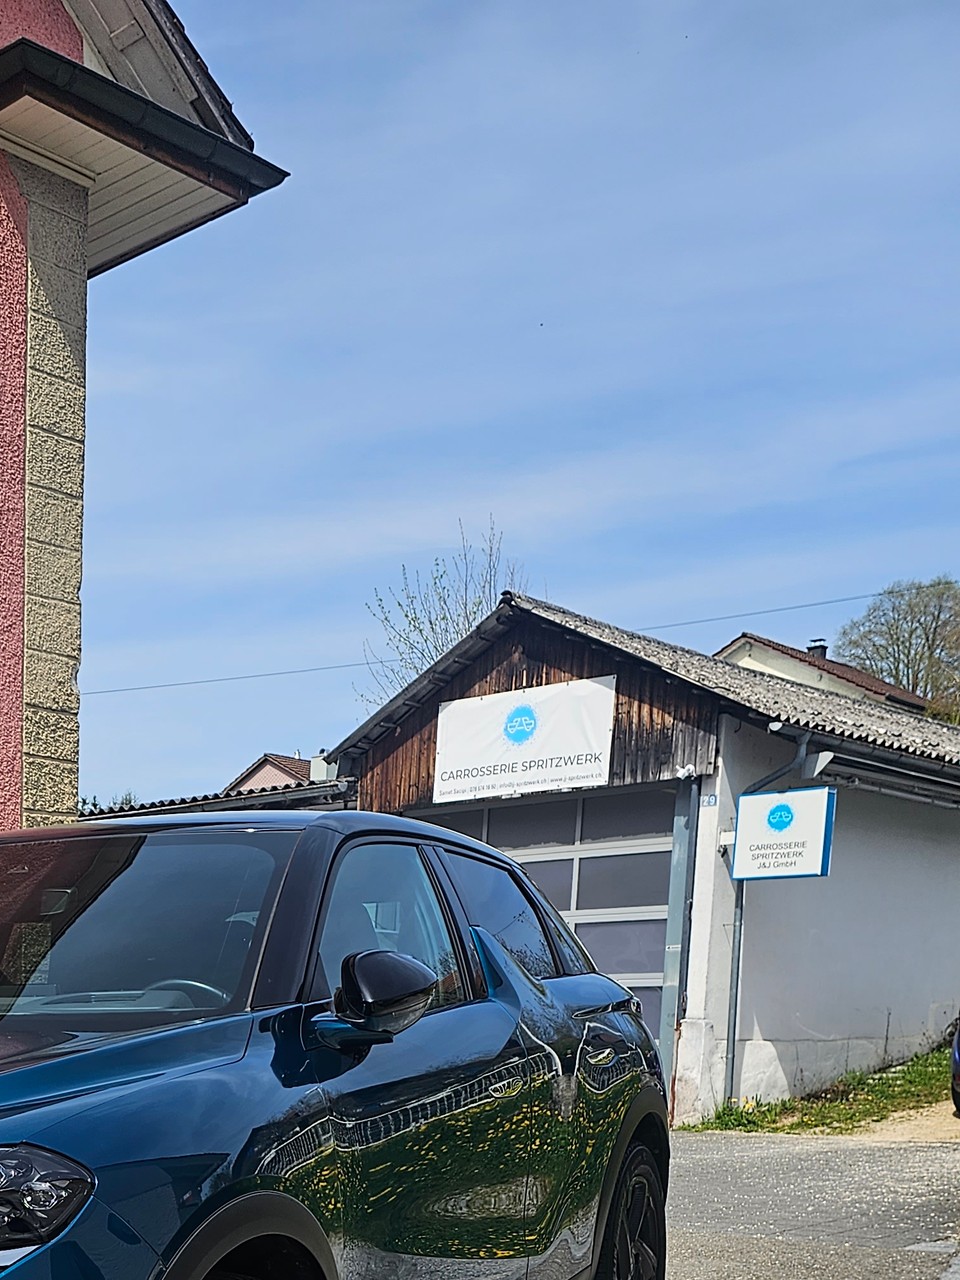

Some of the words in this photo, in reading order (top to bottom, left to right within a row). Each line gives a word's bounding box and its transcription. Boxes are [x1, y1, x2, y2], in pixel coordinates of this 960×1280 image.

[440, 762, 518, 782] CARROSSERIE
[521, 752, 603, 772] SPRITZWERK
[702, 795, 716, 806] 29
[749, 840, 808, 852] CARROSSERIE
[751, 850, 804, 861] SPRITZWERK
[757, 861, 771, 869] J&J
[773, 860, 797, 868] GmbH
